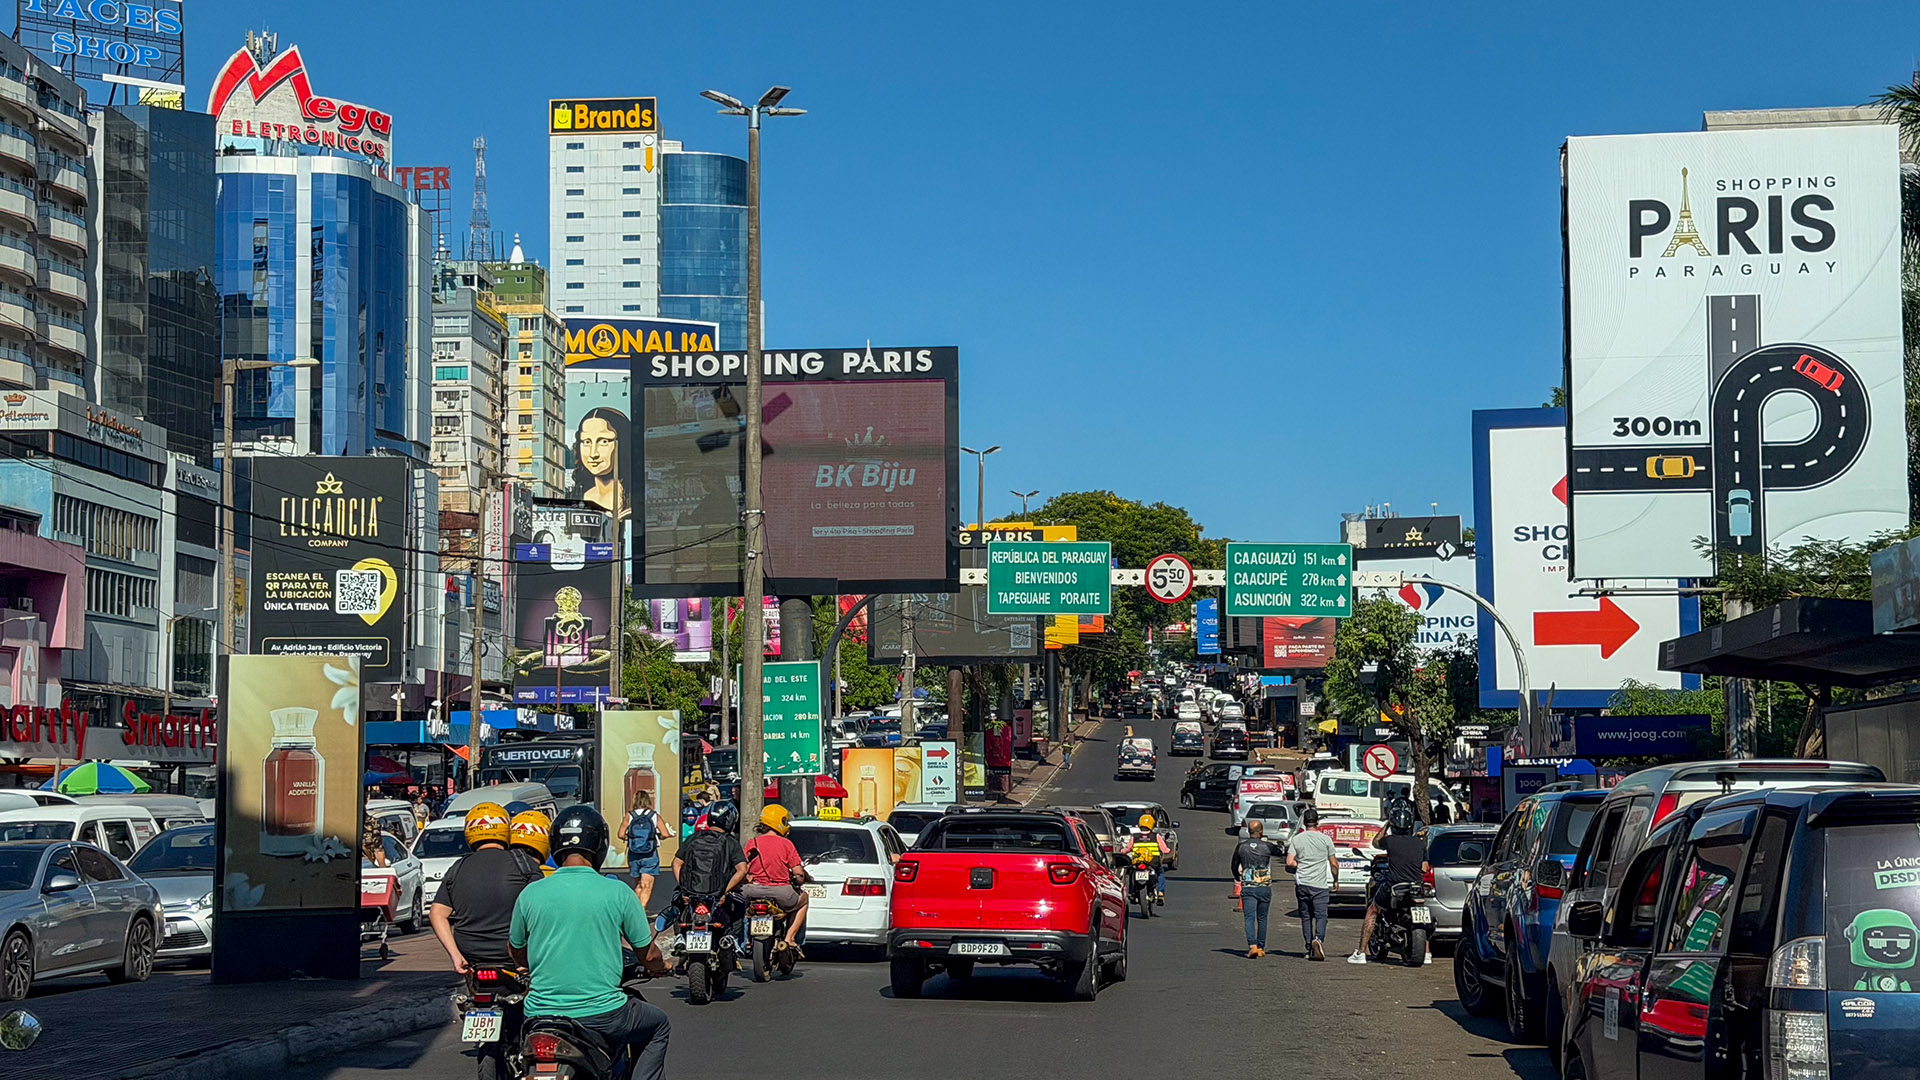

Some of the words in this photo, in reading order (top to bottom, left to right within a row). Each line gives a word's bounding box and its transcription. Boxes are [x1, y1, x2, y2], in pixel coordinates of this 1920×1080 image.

[52, 32, 161, 67] SHOP
[207, 45, 392, 136] Mega
[575, 104, 652, 129] Brands
[1716, 176, 1838, 191] SHOPPING
[1629, 167, 1837, 258] PARIS
[1629, 261, 1837, 278] PARAGUAY
[565, 324, 713, 358] MONALISA
[650, 351, 824, 377] SHOPING
[843, 339, 932, 374] PARIS
[1612, 416, 1701, 437] 300m
[816, 465, 854, 488] BK
[862, 462, 915, 492] Biju
[811, 501, 821, 509] La
[827, 501, 860, 510] belleza
[863, 502, 885, 510] para
[888, 500, 915, 508] todos
[532, 511, 566, 520] extra
[1513, 525, 1568, 542] SHO
[308, 539, 349, 547] COMPANY
[991, 548, 1039, 564] REPÚBLICA
[1042, 551, 1059, 564] DEL
[1062, 551, 1107, 564] PARAGUAY
[1234, 550, 1297, 566] CAAGUAZÚ
[1303, 552, 1317, 566] 151
[266, 573, 310, 581] ESCANEA
[312, 573, 324, 581] EL
[1015, 572, 1078, 584] BIENVENIDOS
[1234, 570, 1287, 586] CAACUPÉ
[1302, 572, 1319, 585] 278
[265, 582, 280, 590] QR
[282, 582, 308, 590] PARA
[310, 582, 329, 590] VER
[266, 591, 278, 599] LA
[280, 589, 332, 599] UBICACIÓN
[998, 592, 1050, 605] TAPEGUAHE
[1060, 592, 1100, 605] PORAITE
[1234, 591, 1291, 606] ASUNCIÓN
[1300, 593, 1317, 606] 322
[264, 600, 294, 611] ÚNICA
[295, 602, 330, 611] TIENDA
[1427, 616, 1475, 629] PING
[791, 675, 807, 683] ESTE
[795, 693, 806, 702] km
[808, 712, 818, 720] km
[799, 731, 809, 739] km
[1598, 729, 1687, 741] www.joog.com
[1877, 861, 1892, 869] LA
[1879, 873, 1920, 885] DESD
[473, 1018, 494, 1027] UBM
[468, 1028, 495, 1038] 3F17
